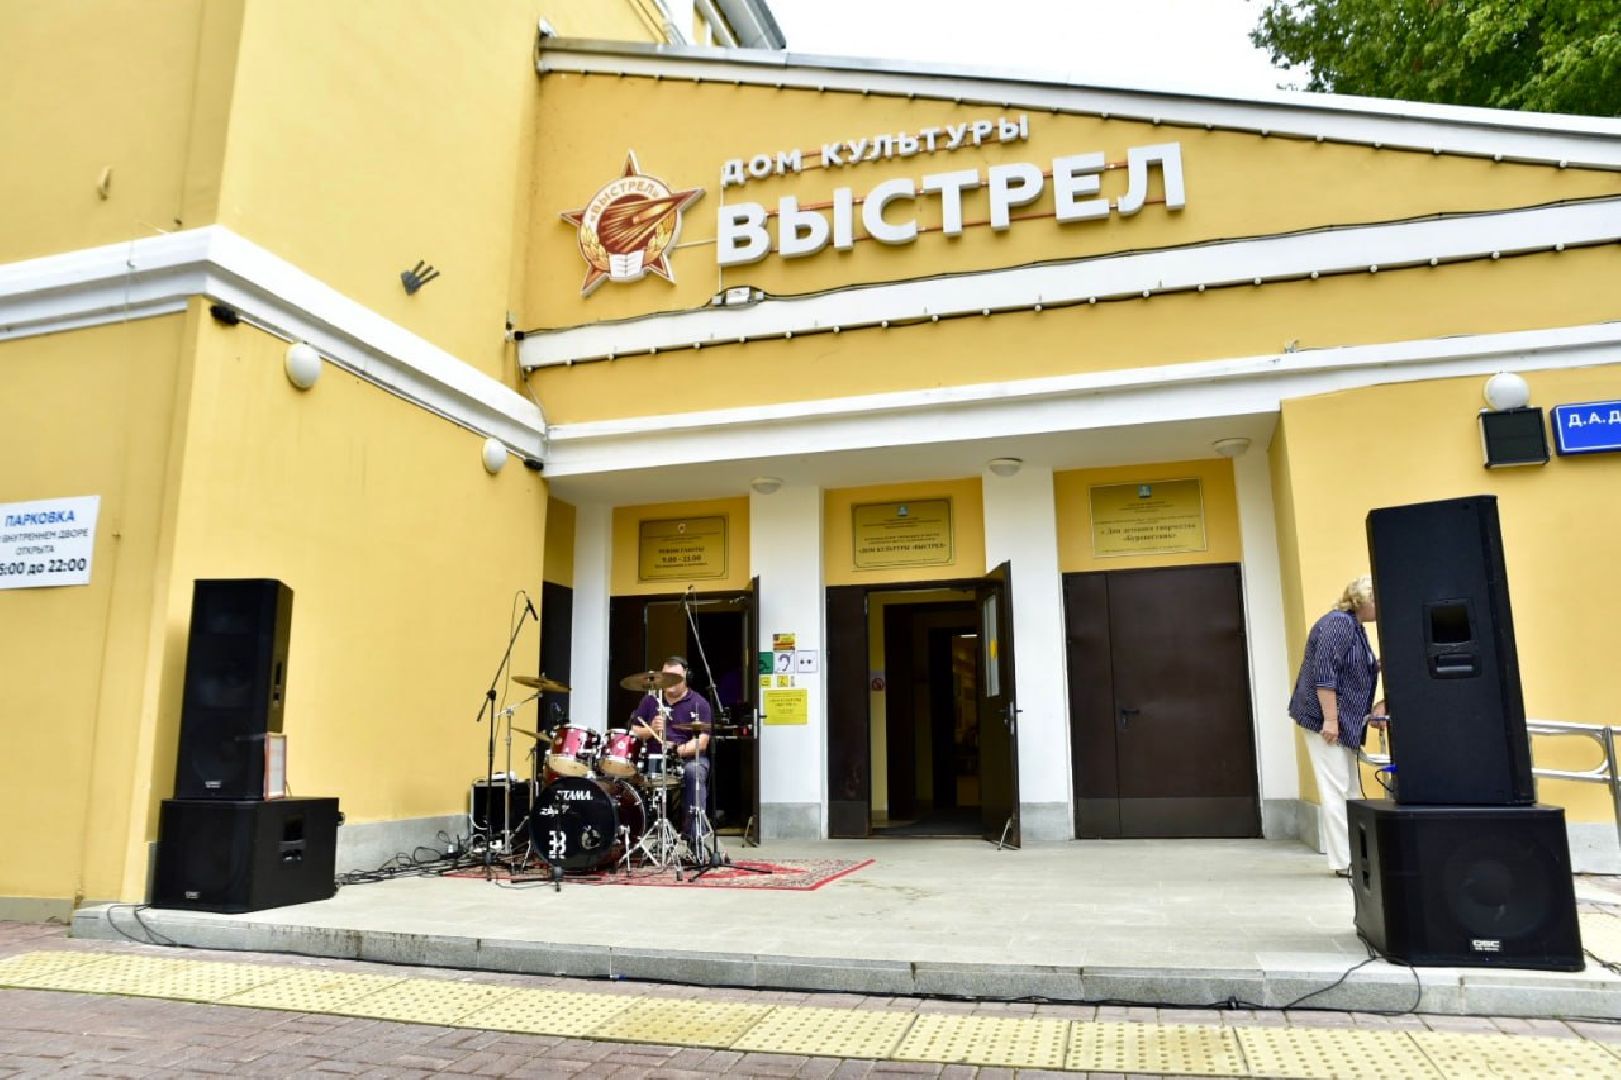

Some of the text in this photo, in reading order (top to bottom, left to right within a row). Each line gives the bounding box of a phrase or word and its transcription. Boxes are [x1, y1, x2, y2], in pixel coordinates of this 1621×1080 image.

[721, 114, 1029, 187] ДОМ КУЛЬТУРЫ
[717, 141, 1185, 266] ВЫСТРЕЛ
[5, 510, 75, 527] ПАРКОВКА
[16, 544, 54, 555] ОТКРЫТА
[27, 563, 45, 576] до
[48, 558, 87, 573] 22:00
